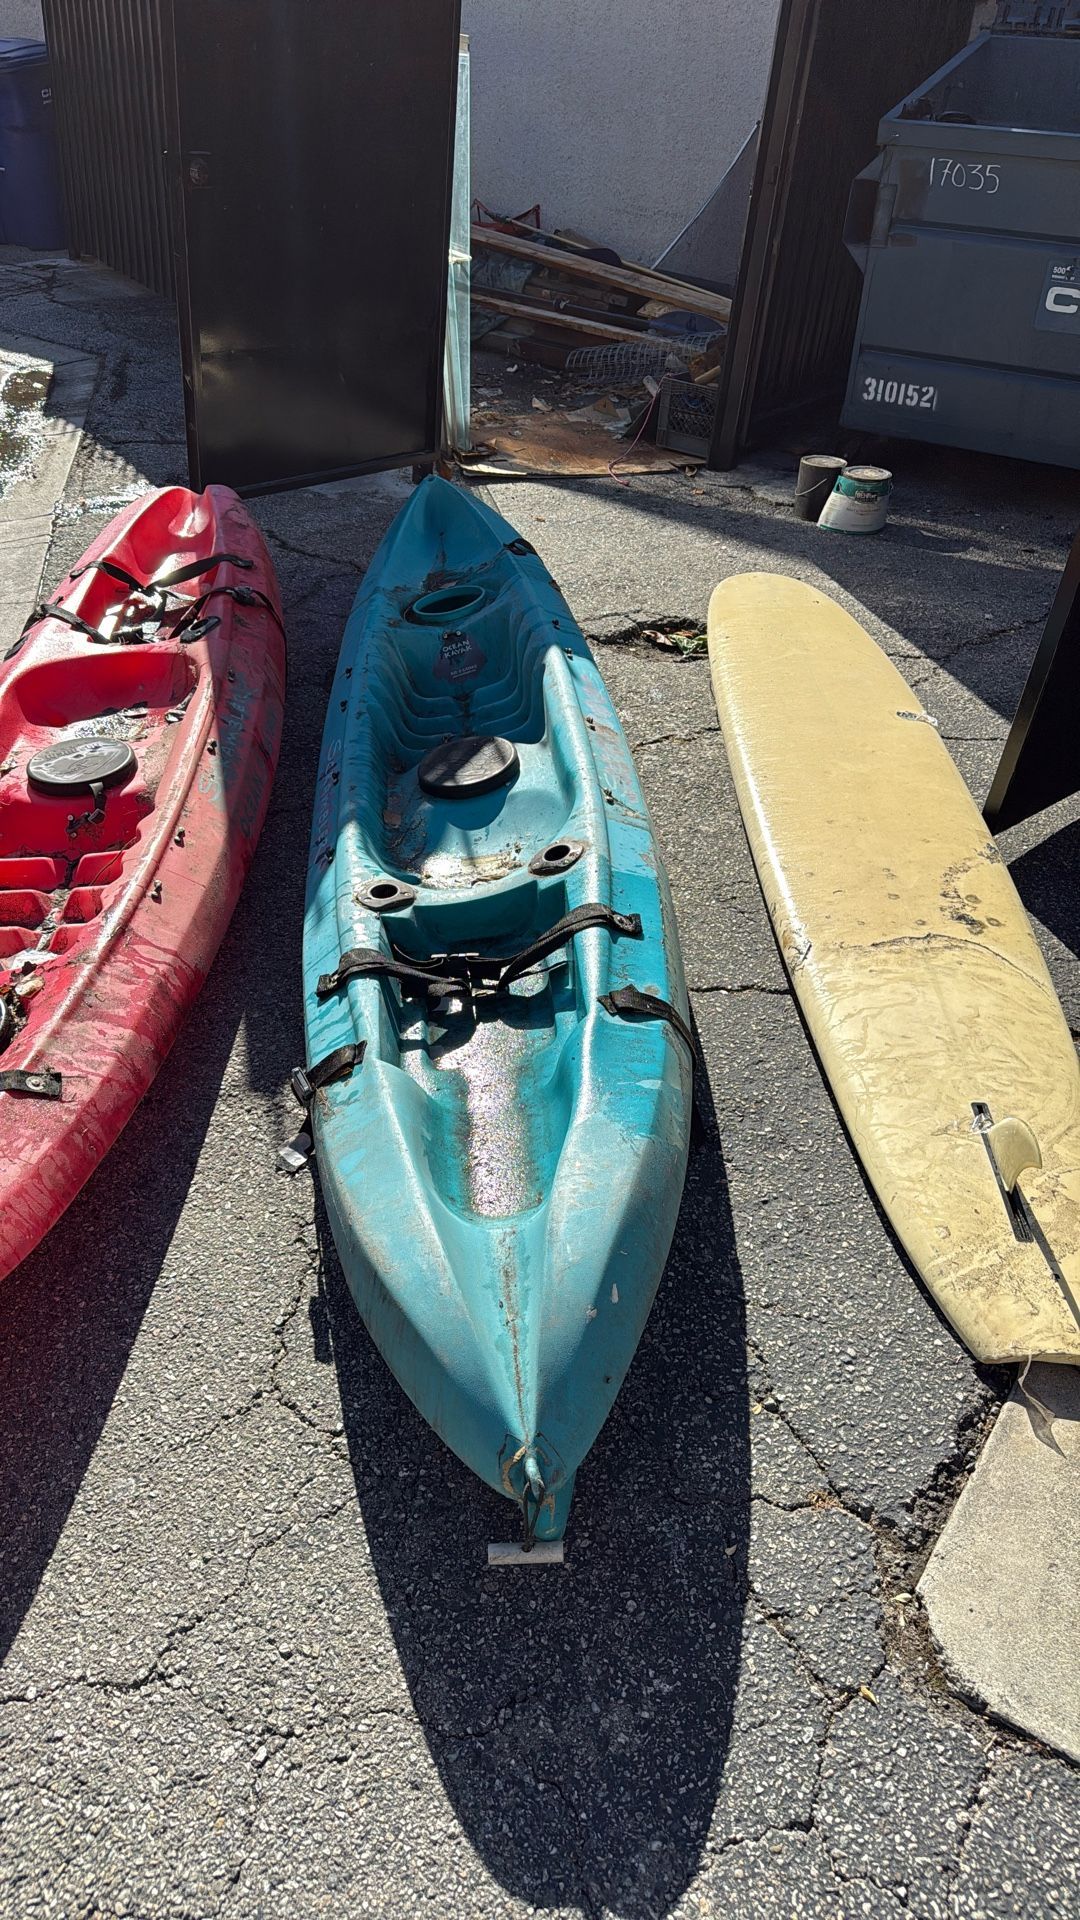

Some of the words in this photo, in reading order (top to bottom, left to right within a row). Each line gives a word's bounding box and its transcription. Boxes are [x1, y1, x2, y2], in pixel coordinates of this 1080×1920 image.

[929, 157, 1002, 193] 17035
[862, 377, 934, 408] 310152
[442, 639, 470, 652] OCEAN
[444, 645, 472, 659] KAYAK
